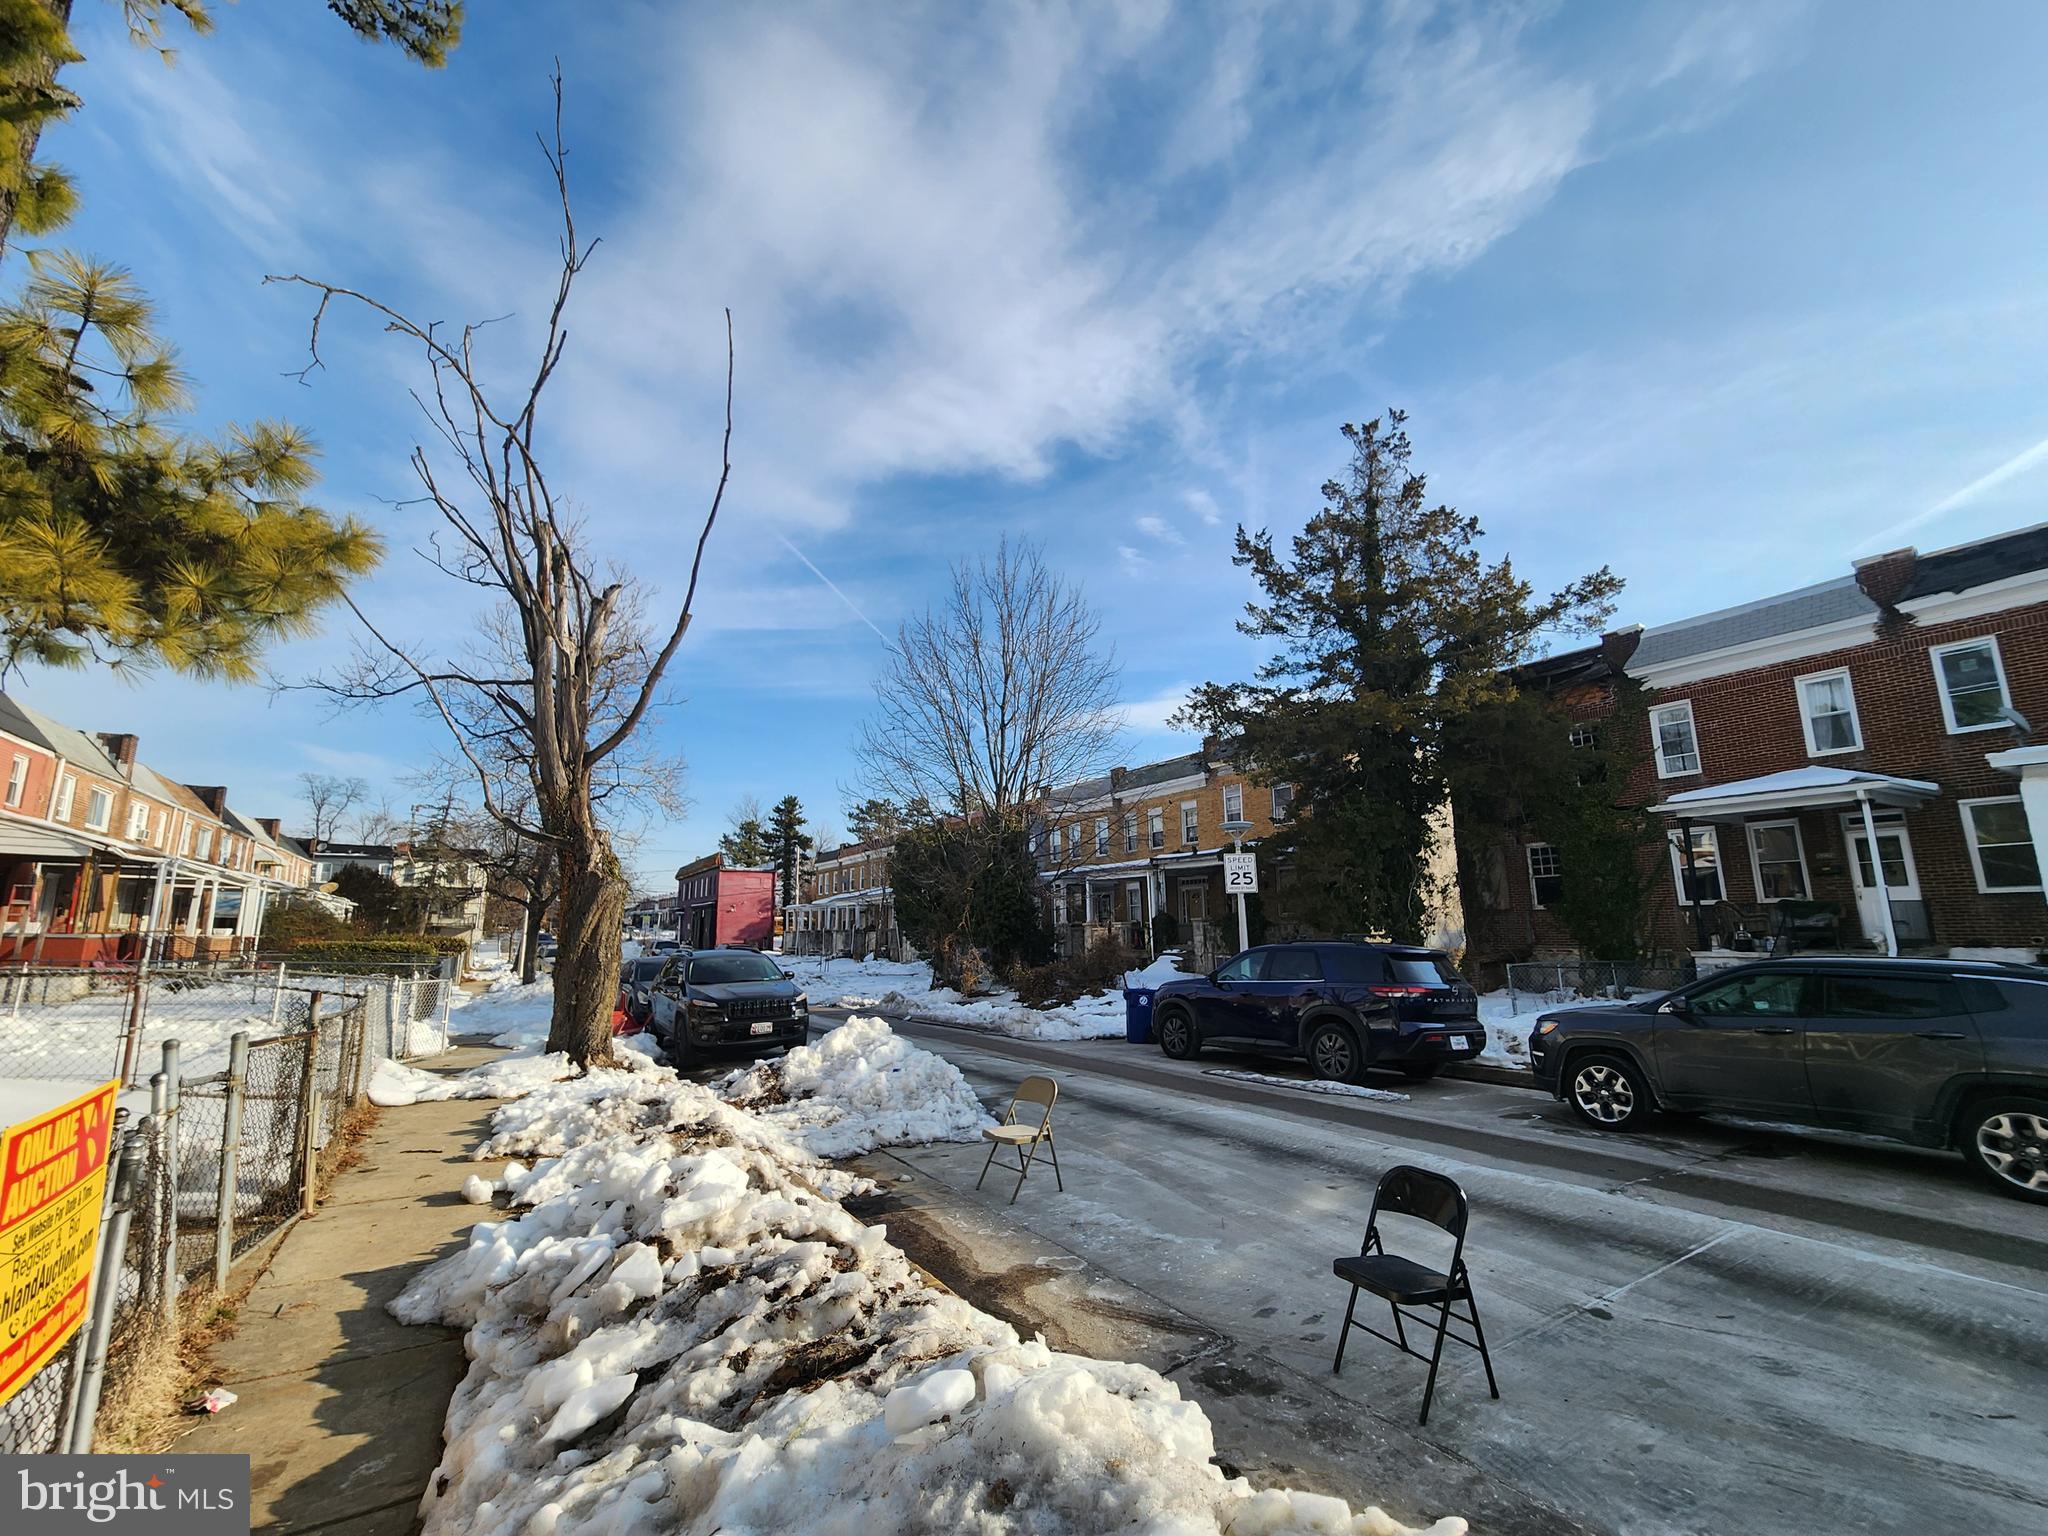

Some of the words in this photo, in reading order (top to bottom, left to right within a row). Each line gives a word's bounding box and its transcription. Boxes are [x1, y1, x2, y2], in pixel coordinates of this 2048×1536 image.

[1230, 872, 1253, 885] 25
[16, 1109, 81, 1175] ONLINE
[1, 1147, 79, 1226] AUCTION
[11, 1239, 54, 1283] Register
[68, 1212, 81, 1239] Bid
[12, 1232, 26, 1252] See
[28, 1213, 54, 1242] Website
[54, 1206, 64, 1224] For
[0, 1227, 94, 1324] hlandAuction.com
